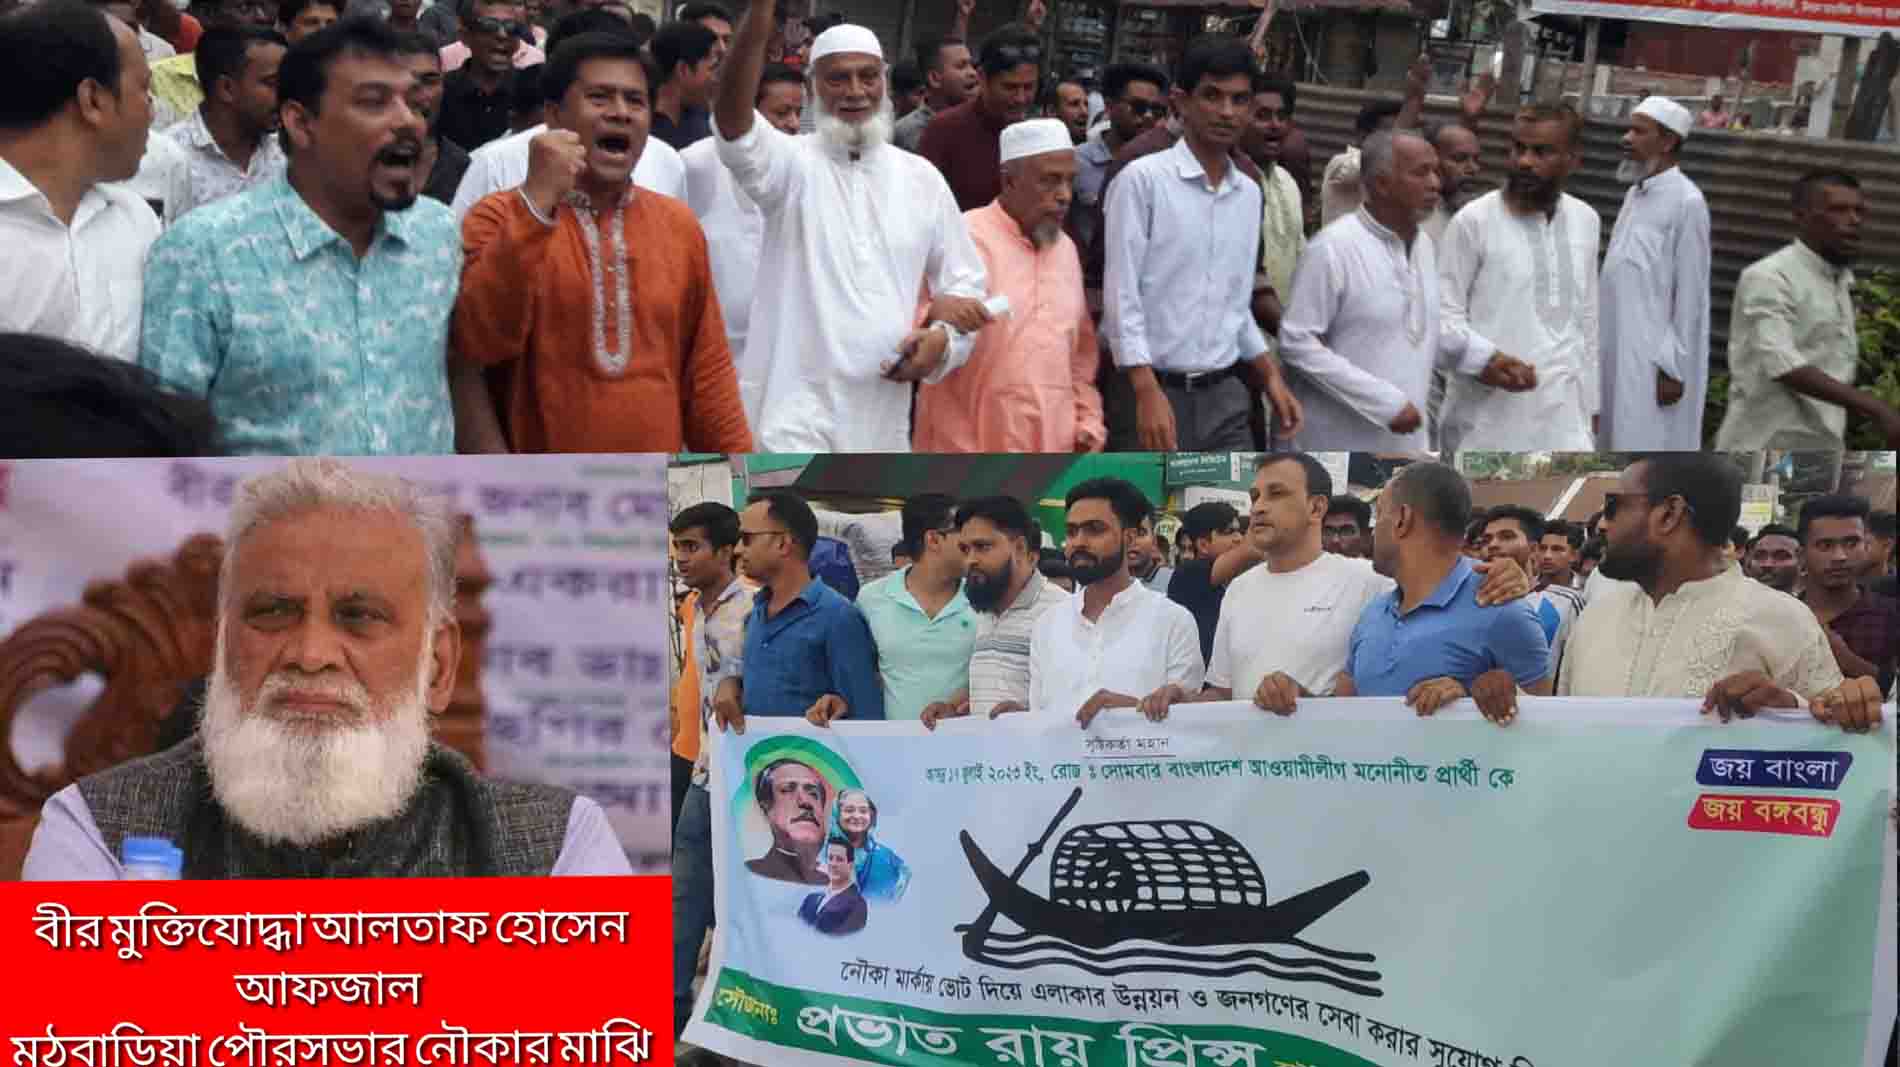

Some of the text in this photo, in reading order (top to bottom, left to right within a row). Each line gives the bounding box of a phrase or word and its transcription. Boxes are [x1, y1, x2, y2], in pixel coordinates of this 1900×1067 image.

[1136, 737, 1169, 750] মহান
[1100, 760, 1162, 782] সোমবার
[1166, 758, 1243, 781] বাংলাদেশ
[1247, 753, 1347, 781] আওয়ামীলীগ
[1351, 756, 1430, 784] মনোনীত
[1434, 758, 1480, 787] প্রার্থী
[1487, 766, 1515, 789] কে
[1709, 757, 1839, 784] জয় বাংলা
[1701, 797, 1834, 835] জয় বঙ্গবন্ধু
[840, 959, 890, 986] নৌকা
[895, 965, 936, 994] মার্কায়
[938, 976, 973, 1001] ভোট
[978, 976, 1023, 1002] দিয়ে
[1031, 982, 1106, 1009] এলাকার
[1112, 983, 1180, 1014] উন্নয়ন
[1190, 988, 1209, 1008] ও
[1213, 987, 1311, 1024] জনগণের
[1316, 1001, 1362, 1039] সেবা
[1366, 1017, 1422, 1060] করার
[797, 1004, 963, 1056] প্রভাত
[979, 1024, 1096, 1067] রায়
